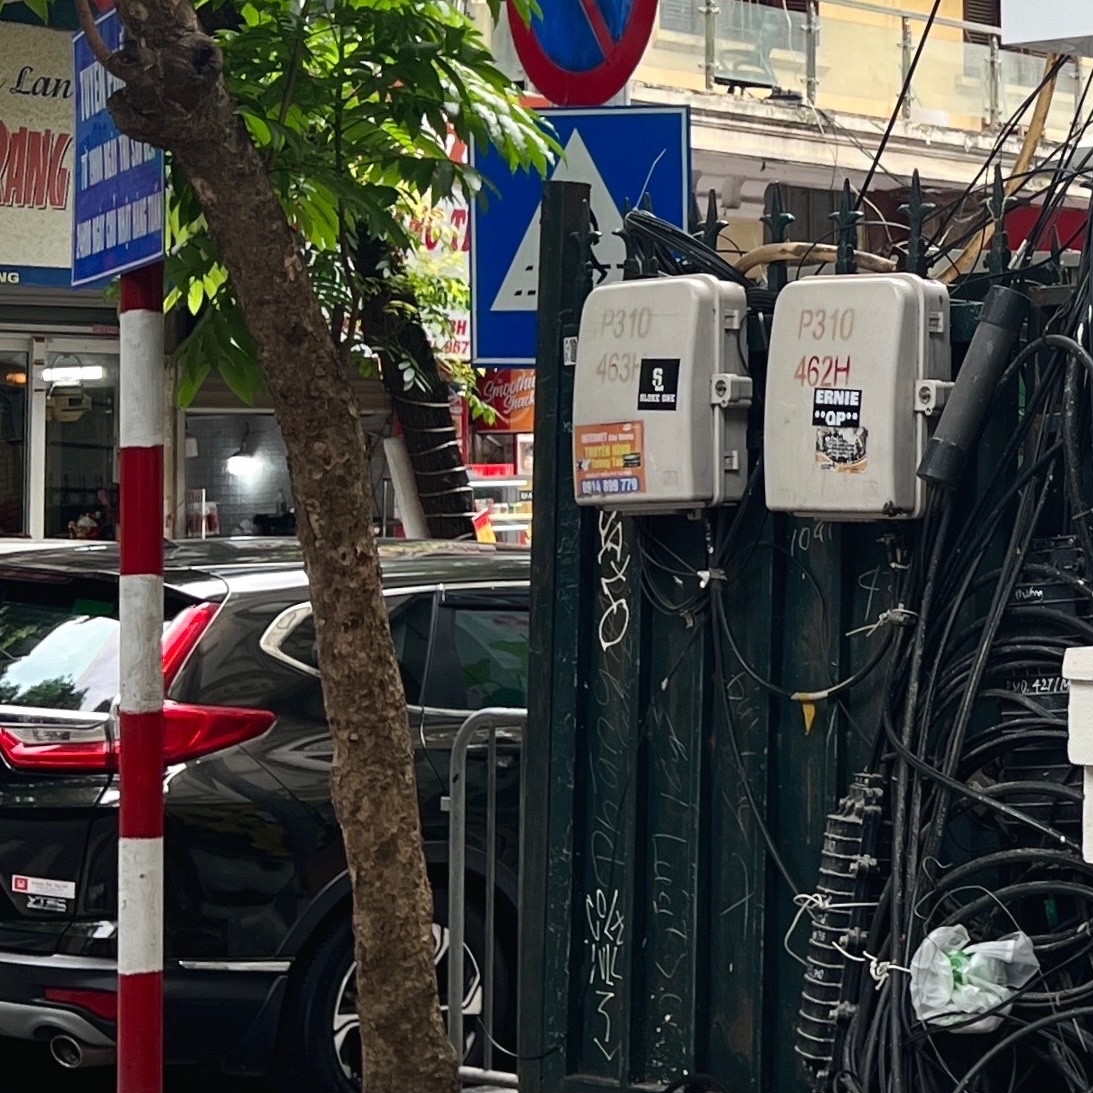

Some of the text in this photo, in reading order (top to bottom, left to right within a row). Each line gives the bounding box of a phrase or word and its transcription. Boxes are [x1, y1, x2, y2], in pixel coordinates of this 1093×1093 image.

[10, 66, 73, 99] Lan
[799, 308, 855, 342] P310
[794, 355, 851, 387] 462H
[815, 389, 859, 406] ERNIE
